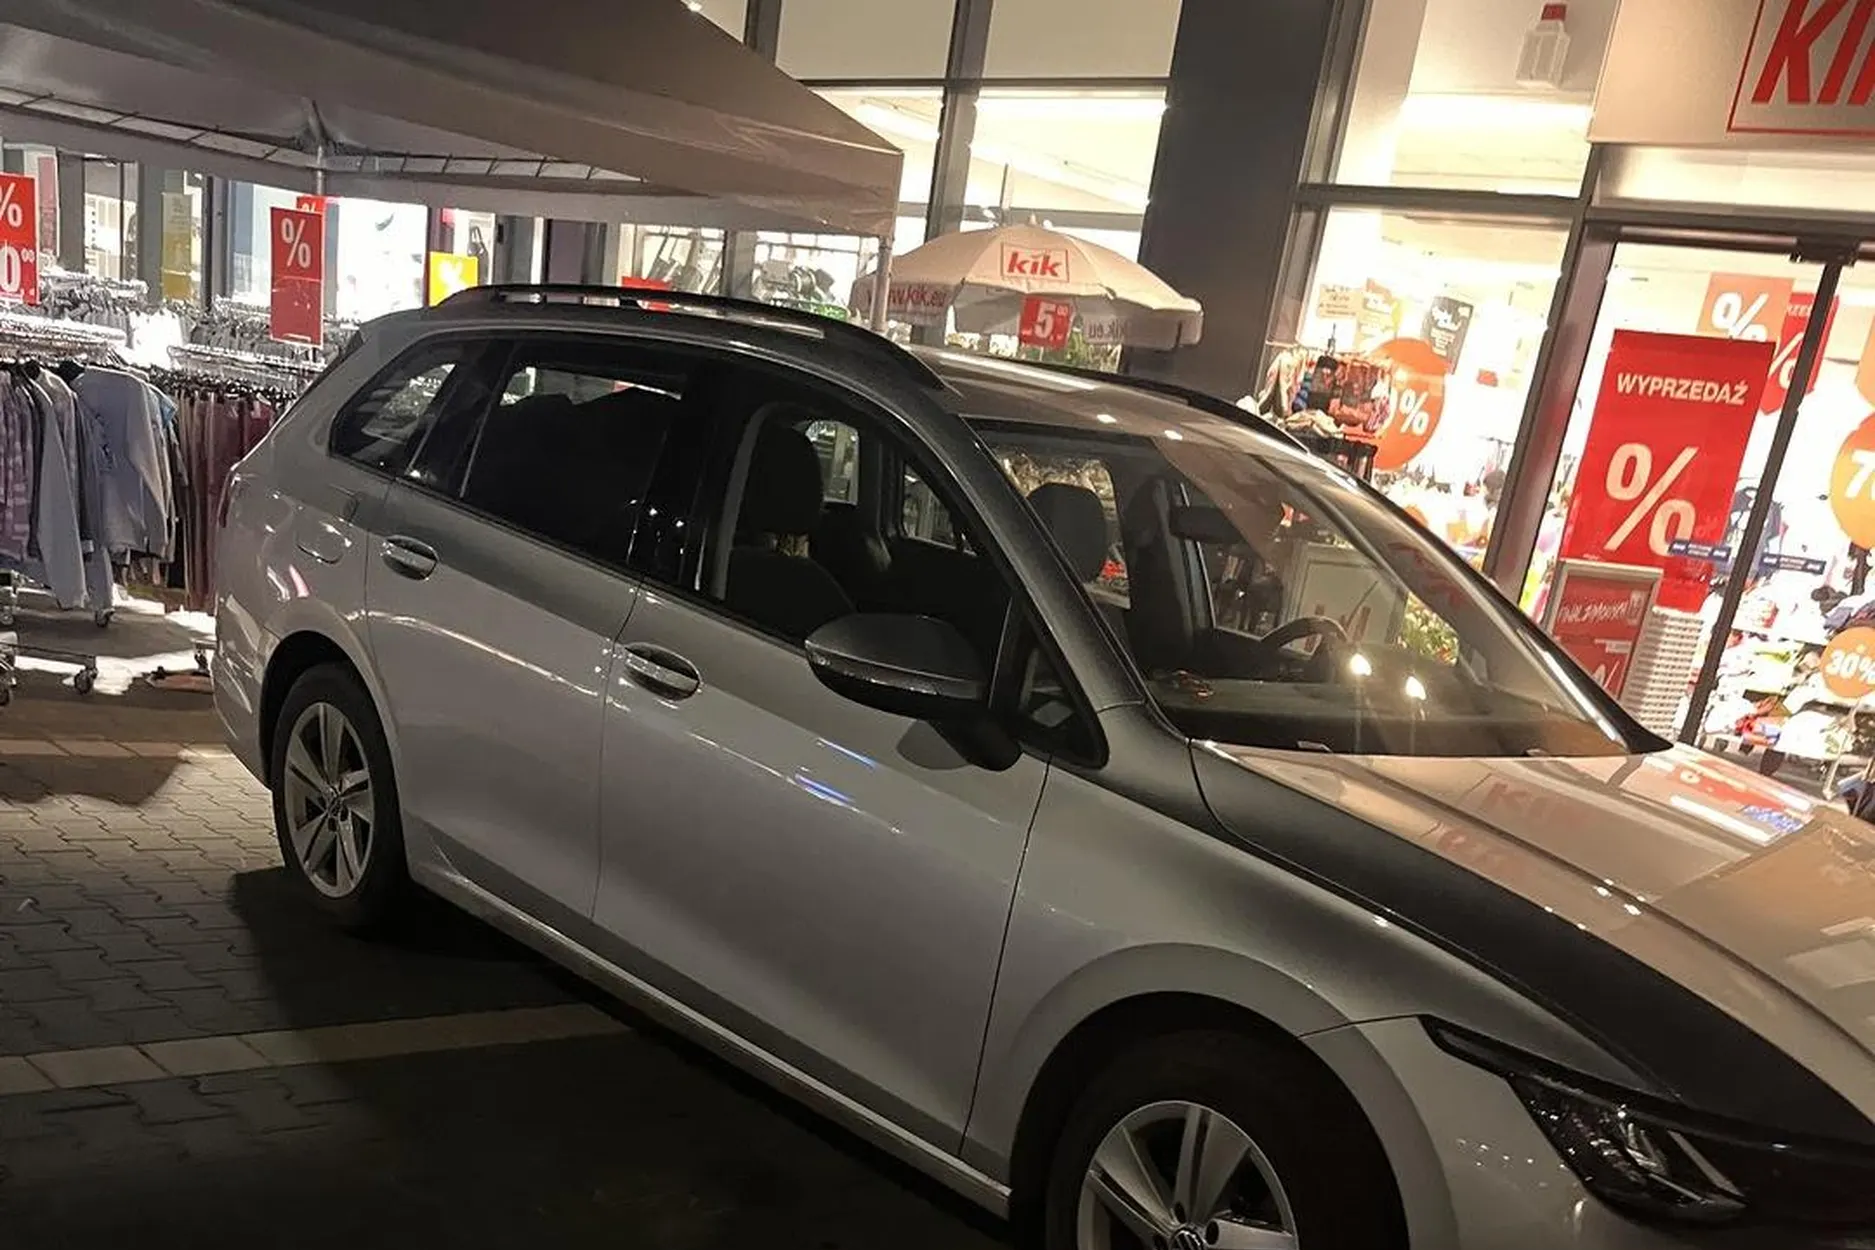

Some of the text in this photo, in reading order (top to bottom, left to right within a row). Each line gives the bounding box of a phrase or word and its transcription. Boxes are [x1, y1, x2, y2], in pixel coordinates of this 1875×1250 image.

[1751, 0, 1875, 105] KI
[281, 217, 311, 268] %
[1006, 250, 1061, 277] kik
[1617, 373, 1748, 405] WYPRZEDAŻ
[1603, 443, 1699, 557] %
